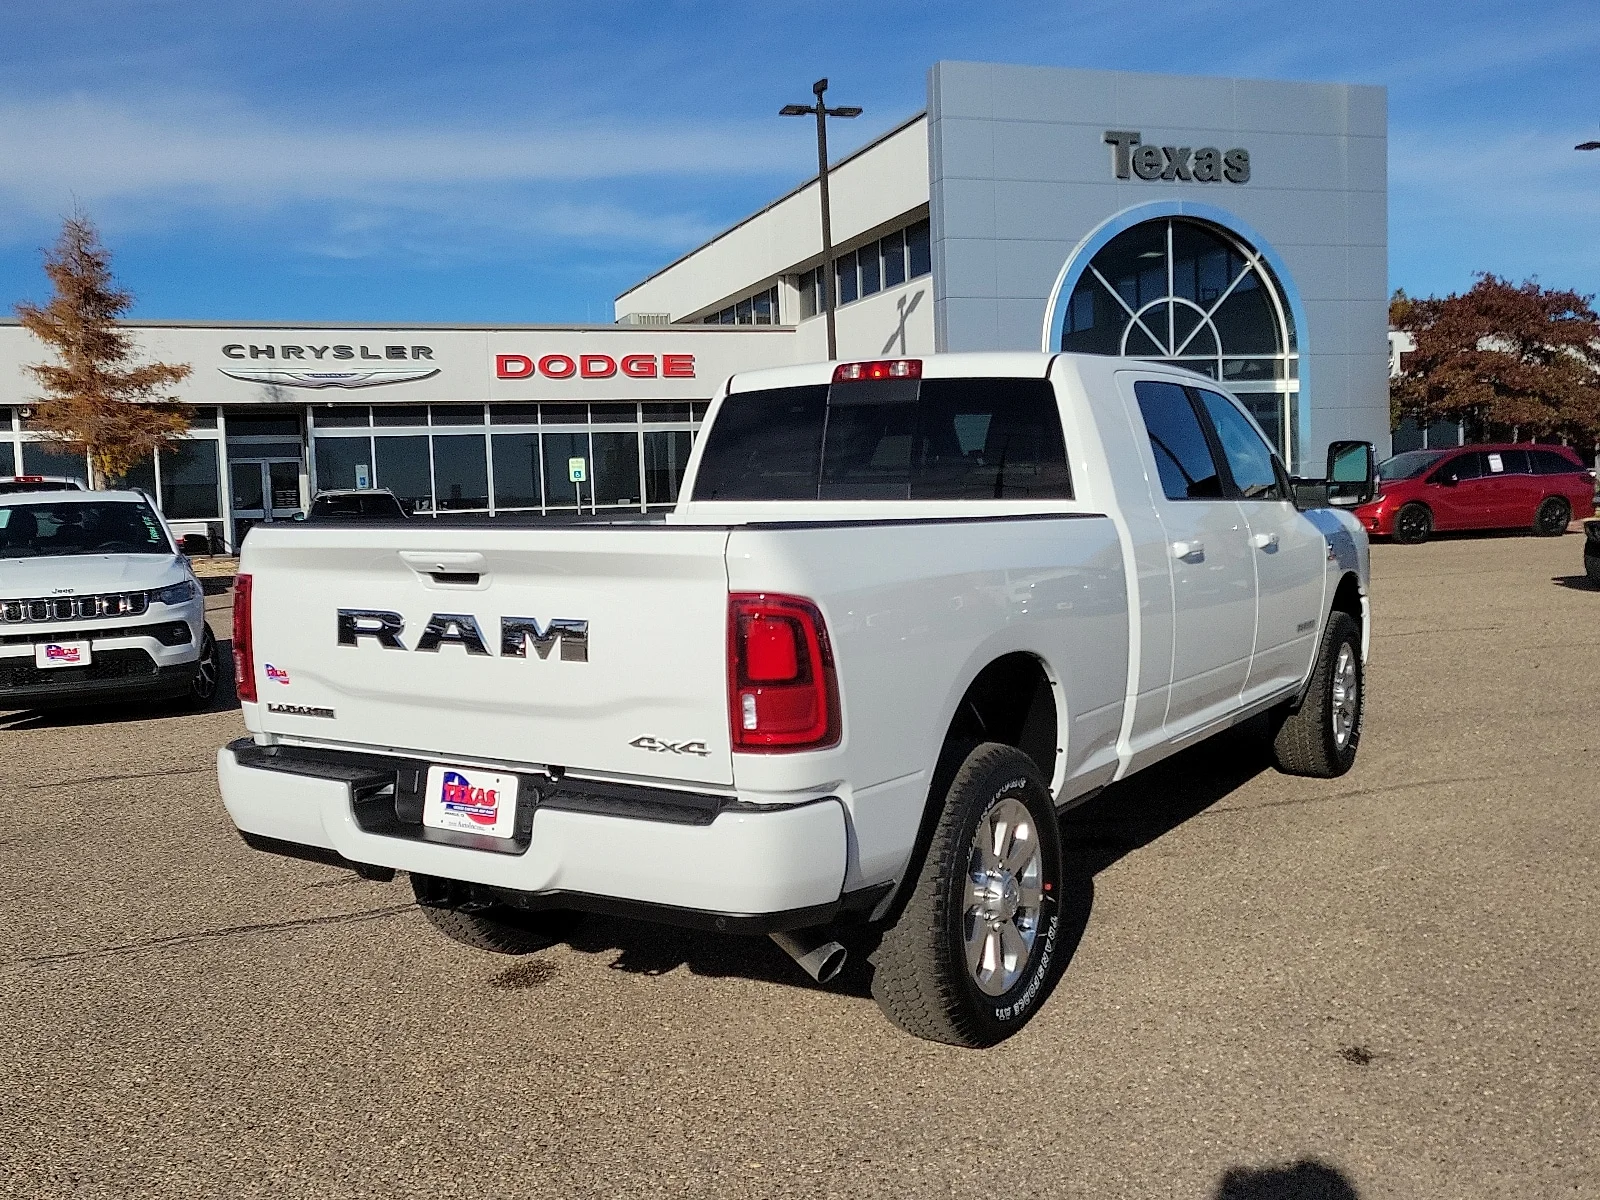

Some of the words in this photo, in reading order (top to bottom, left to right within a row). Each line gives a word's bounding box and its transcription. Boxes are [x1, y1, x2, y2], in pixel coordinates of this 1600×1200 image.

[1104, 131, 1250, 184] Texas
[221, 343, 435, 361] CHRYSLER
[496, 354, 696, 379] DODGE
[336, 607, 589, 663] RAM
[444, 783, 497, 807] TEXAS
